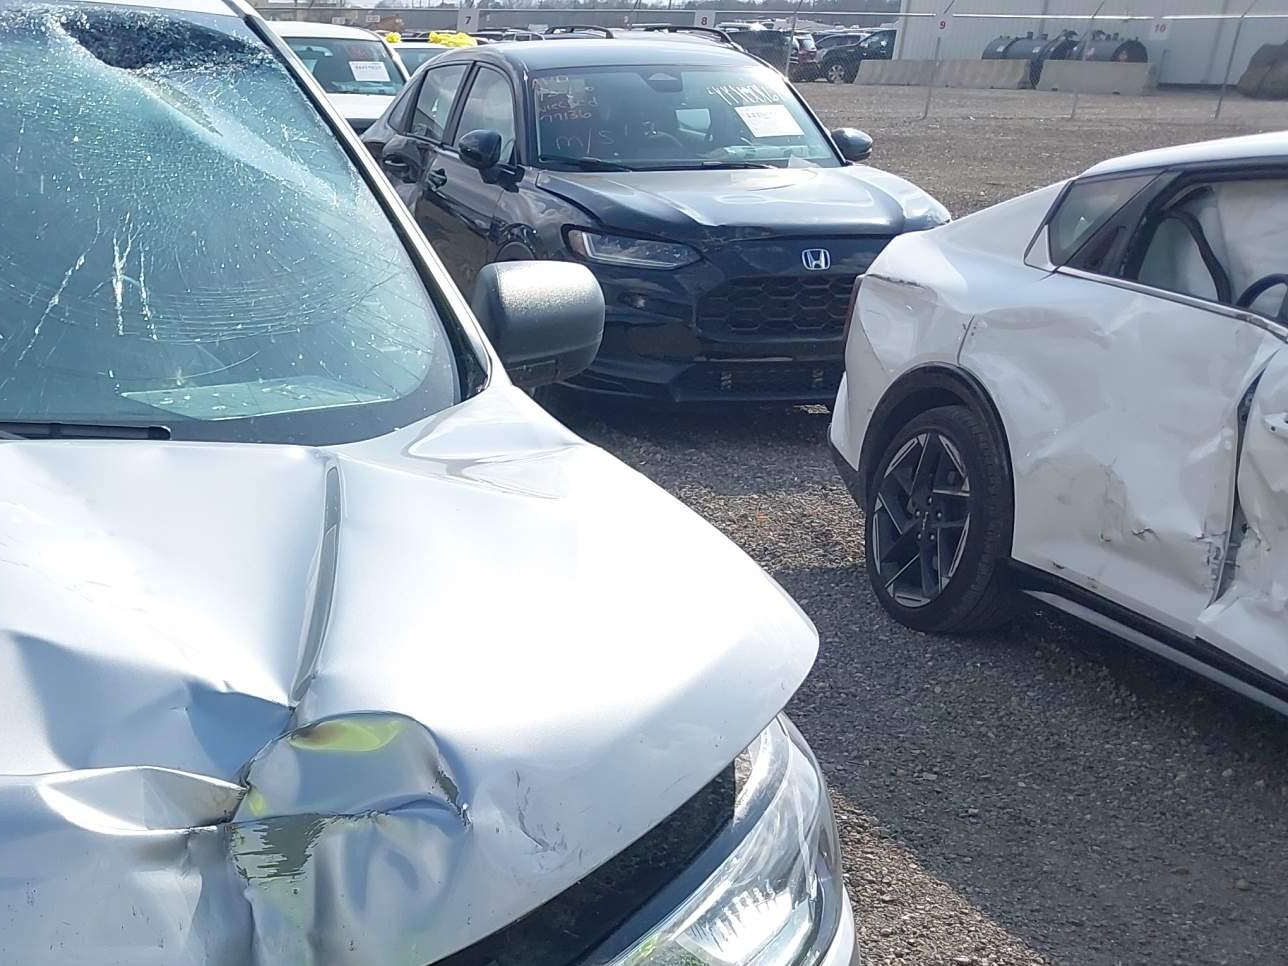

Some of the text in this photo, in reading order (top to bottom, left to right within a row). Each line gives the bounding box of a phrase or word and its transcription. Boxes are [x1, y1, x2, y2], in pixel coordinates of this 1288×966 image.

[464, 15, 472, 24] 7
[700, 16, 708, 26] 8
[939, 20, 946, 30] 9
[1153, 23, 1167, 33] 10
